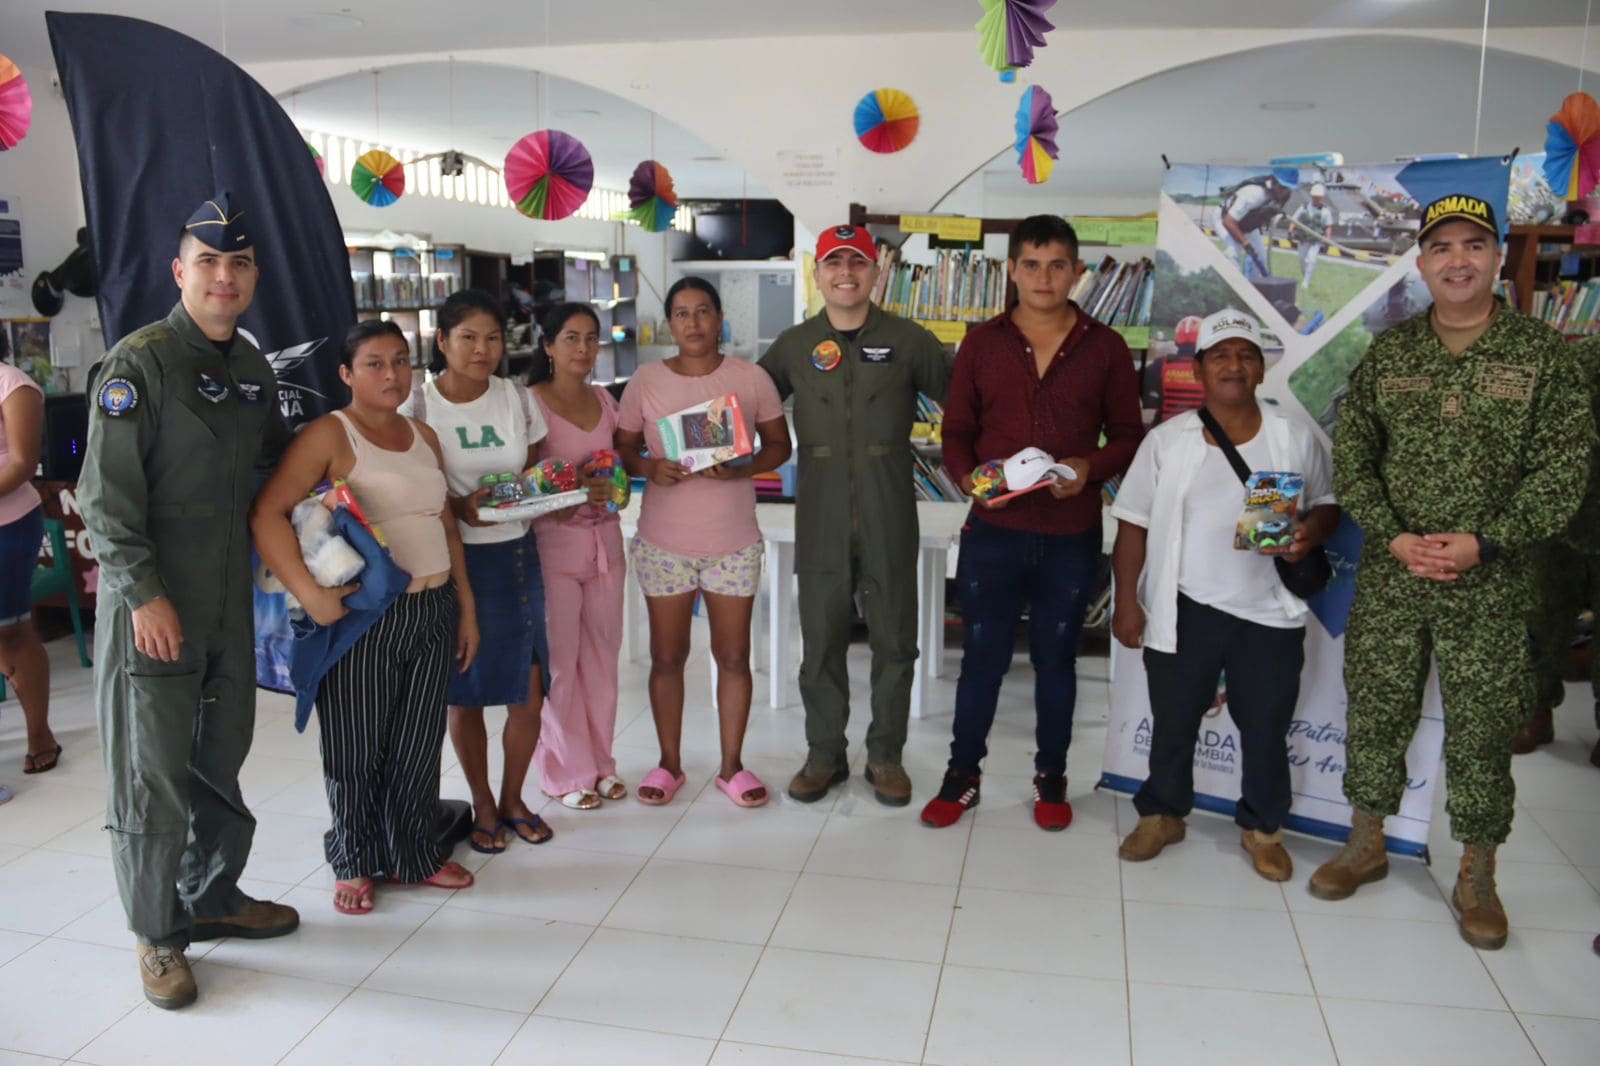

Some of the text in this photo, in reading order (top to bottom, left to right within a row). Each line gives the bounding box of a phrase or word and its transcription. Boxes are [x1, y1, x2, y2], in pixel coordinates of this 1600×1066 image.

[1426, 196, 1488, 222] ARMADA
[277, 389, 303, 401] CIAL
[279, 400, 304, 418] NA
[455, 425, 506, 449] LA
[1196, 747, 1236, 765] MBIA
